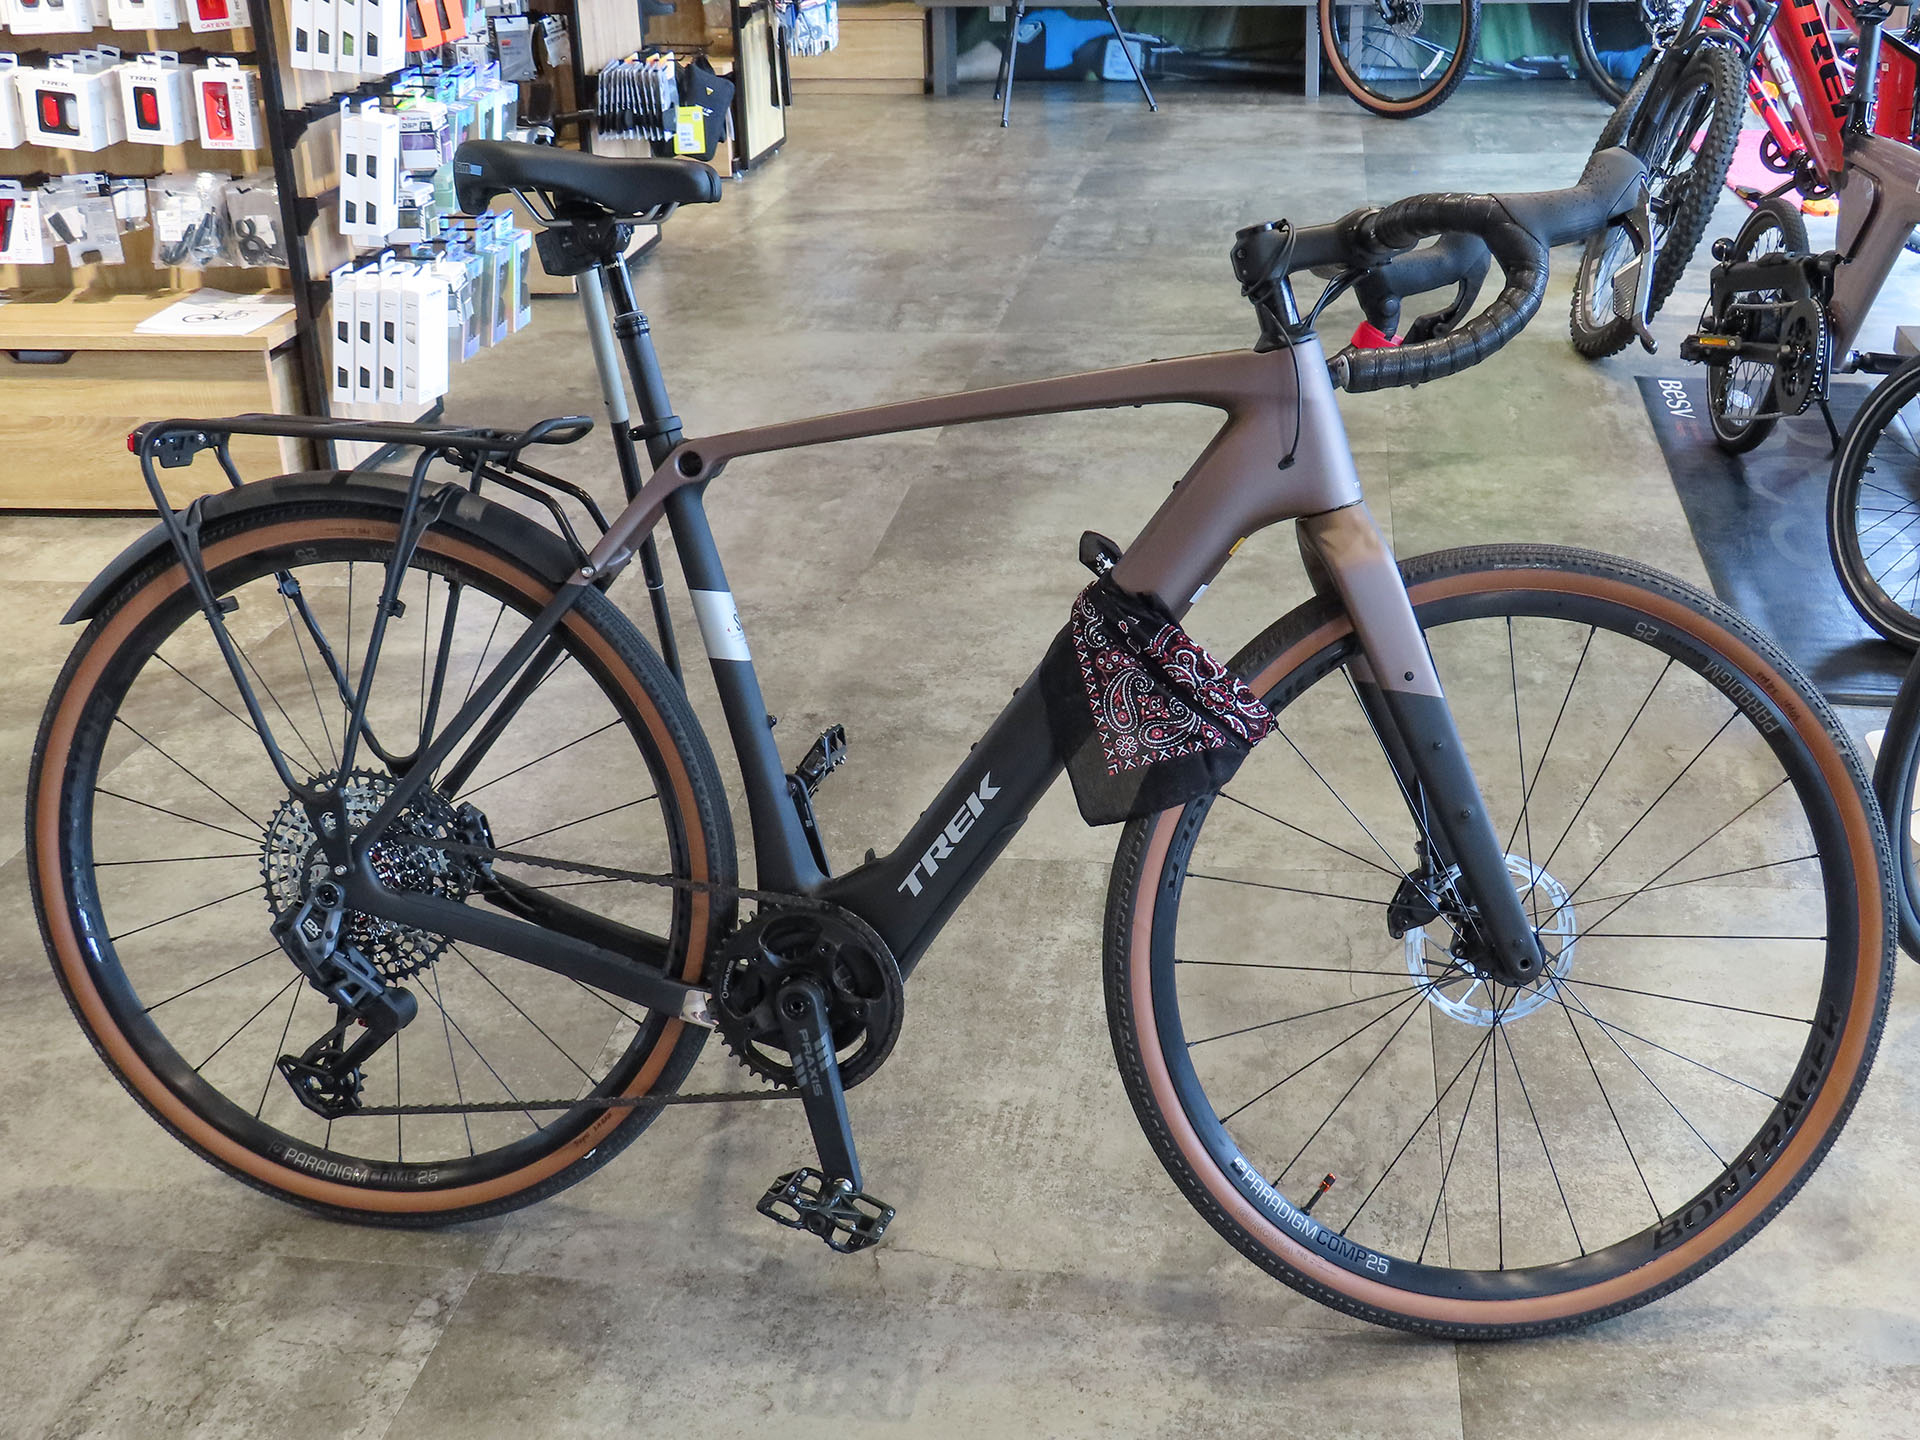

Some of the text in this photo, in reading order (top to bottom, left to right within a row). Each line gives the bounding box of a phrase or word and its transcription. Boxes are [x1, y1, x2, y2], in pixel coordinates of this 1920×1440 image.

[1762, 30, 1802, 111] REK
[1632, 621, 1660, 643] 25
[1700, 661, 1780, 734] PARADIGM
[897, 771, 1001, 897] TREK
[797, 1028, 823, 1097] PRAXIS
[283, 1147, 368, 1184] PARADIGM
[417, 1169, 439, 1184] 25
[1242, 1169, 1318, 1240] PARADIGM
[1316, 1229, 1368, 1264] COMP
[1364, 1253, 1390, 1275] 25
